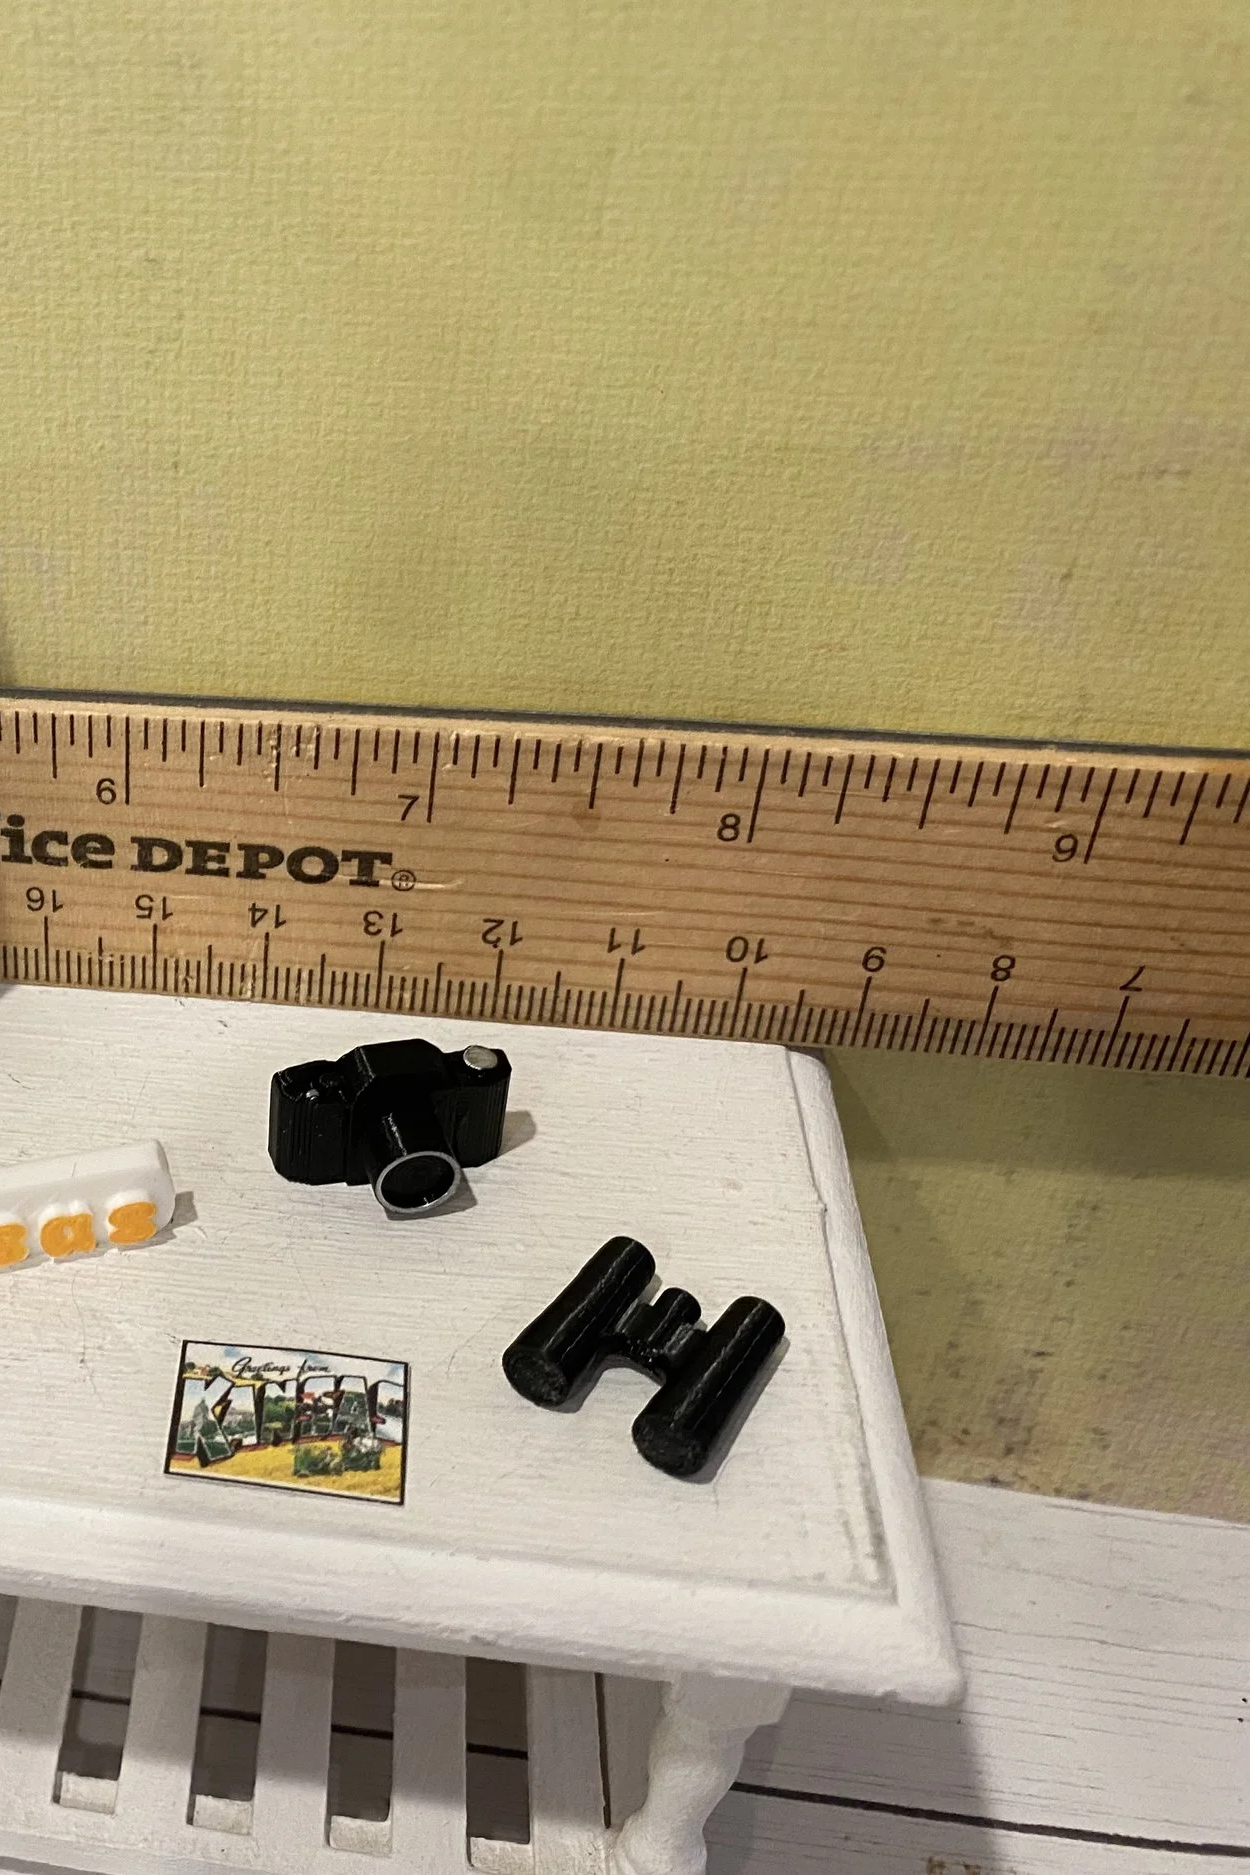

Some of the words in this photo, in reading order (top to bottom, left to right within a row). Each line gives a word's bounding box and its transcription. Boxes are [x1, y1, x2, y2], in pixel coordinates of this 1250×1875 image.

[96, 778, 117, 805] 6
[397, 794, 420, 822] 7
[717, 813, 741, 842] 8
[129, 835, 393, 888] DEPOT
[1052, 834, 1078, 863] 9
[25, 886, 64, 913] 16
[134, 894, 174, 921] 15
[248, 903, 287, 930] 14
[362, 910, 404, 938] 13
[481, 919, 523, 948] 12
[606, 927, 646, 956] 11
[724, 935, 769, 965] 10
